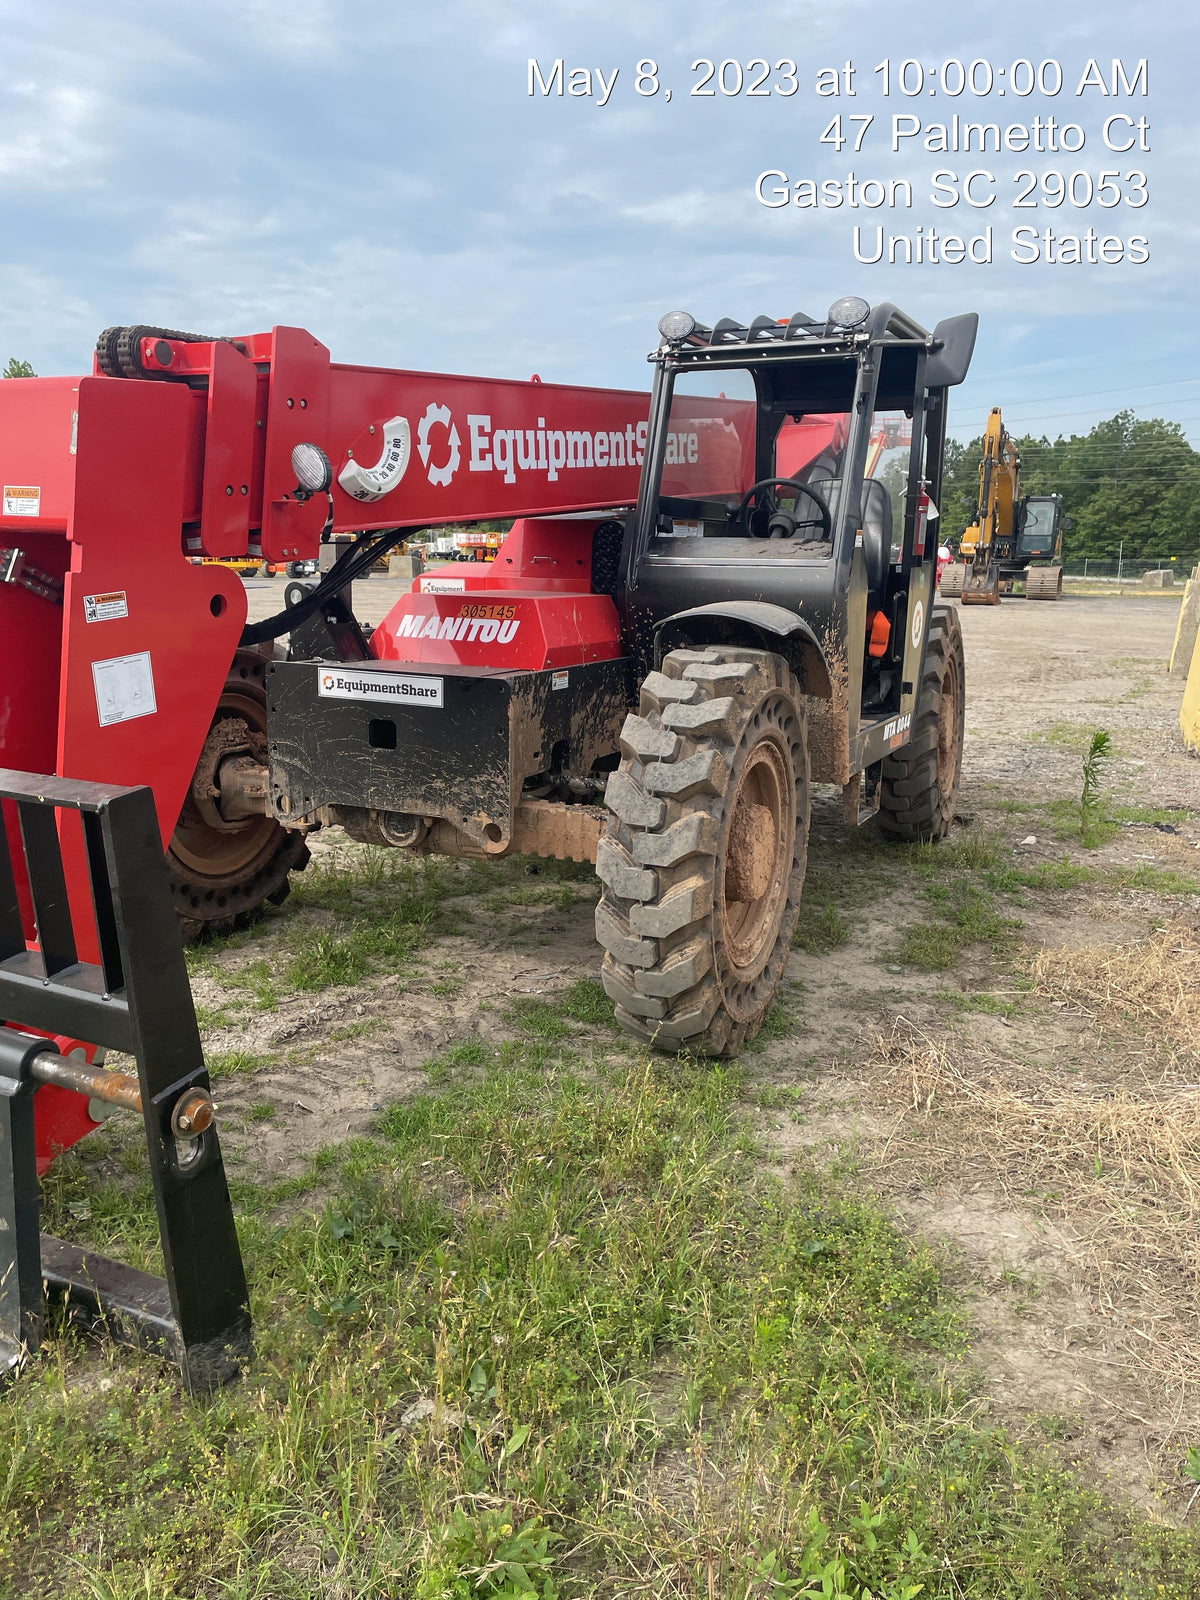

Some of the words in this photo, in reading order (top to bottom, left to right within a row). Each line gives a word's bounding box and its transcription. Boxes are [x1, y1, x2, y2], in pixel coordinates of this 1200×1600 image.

[393, 438, 401, 449] 80
[467, 414, 699, 484] EquipmentSare
[391, 452, 399, 462] 60
[386, 463, 395, 472] 40
[460, 604, 515, 619] 305145
[396, 614, 520, 644] MANITOU
[336, 678, 437, 698] EquipmentShare
